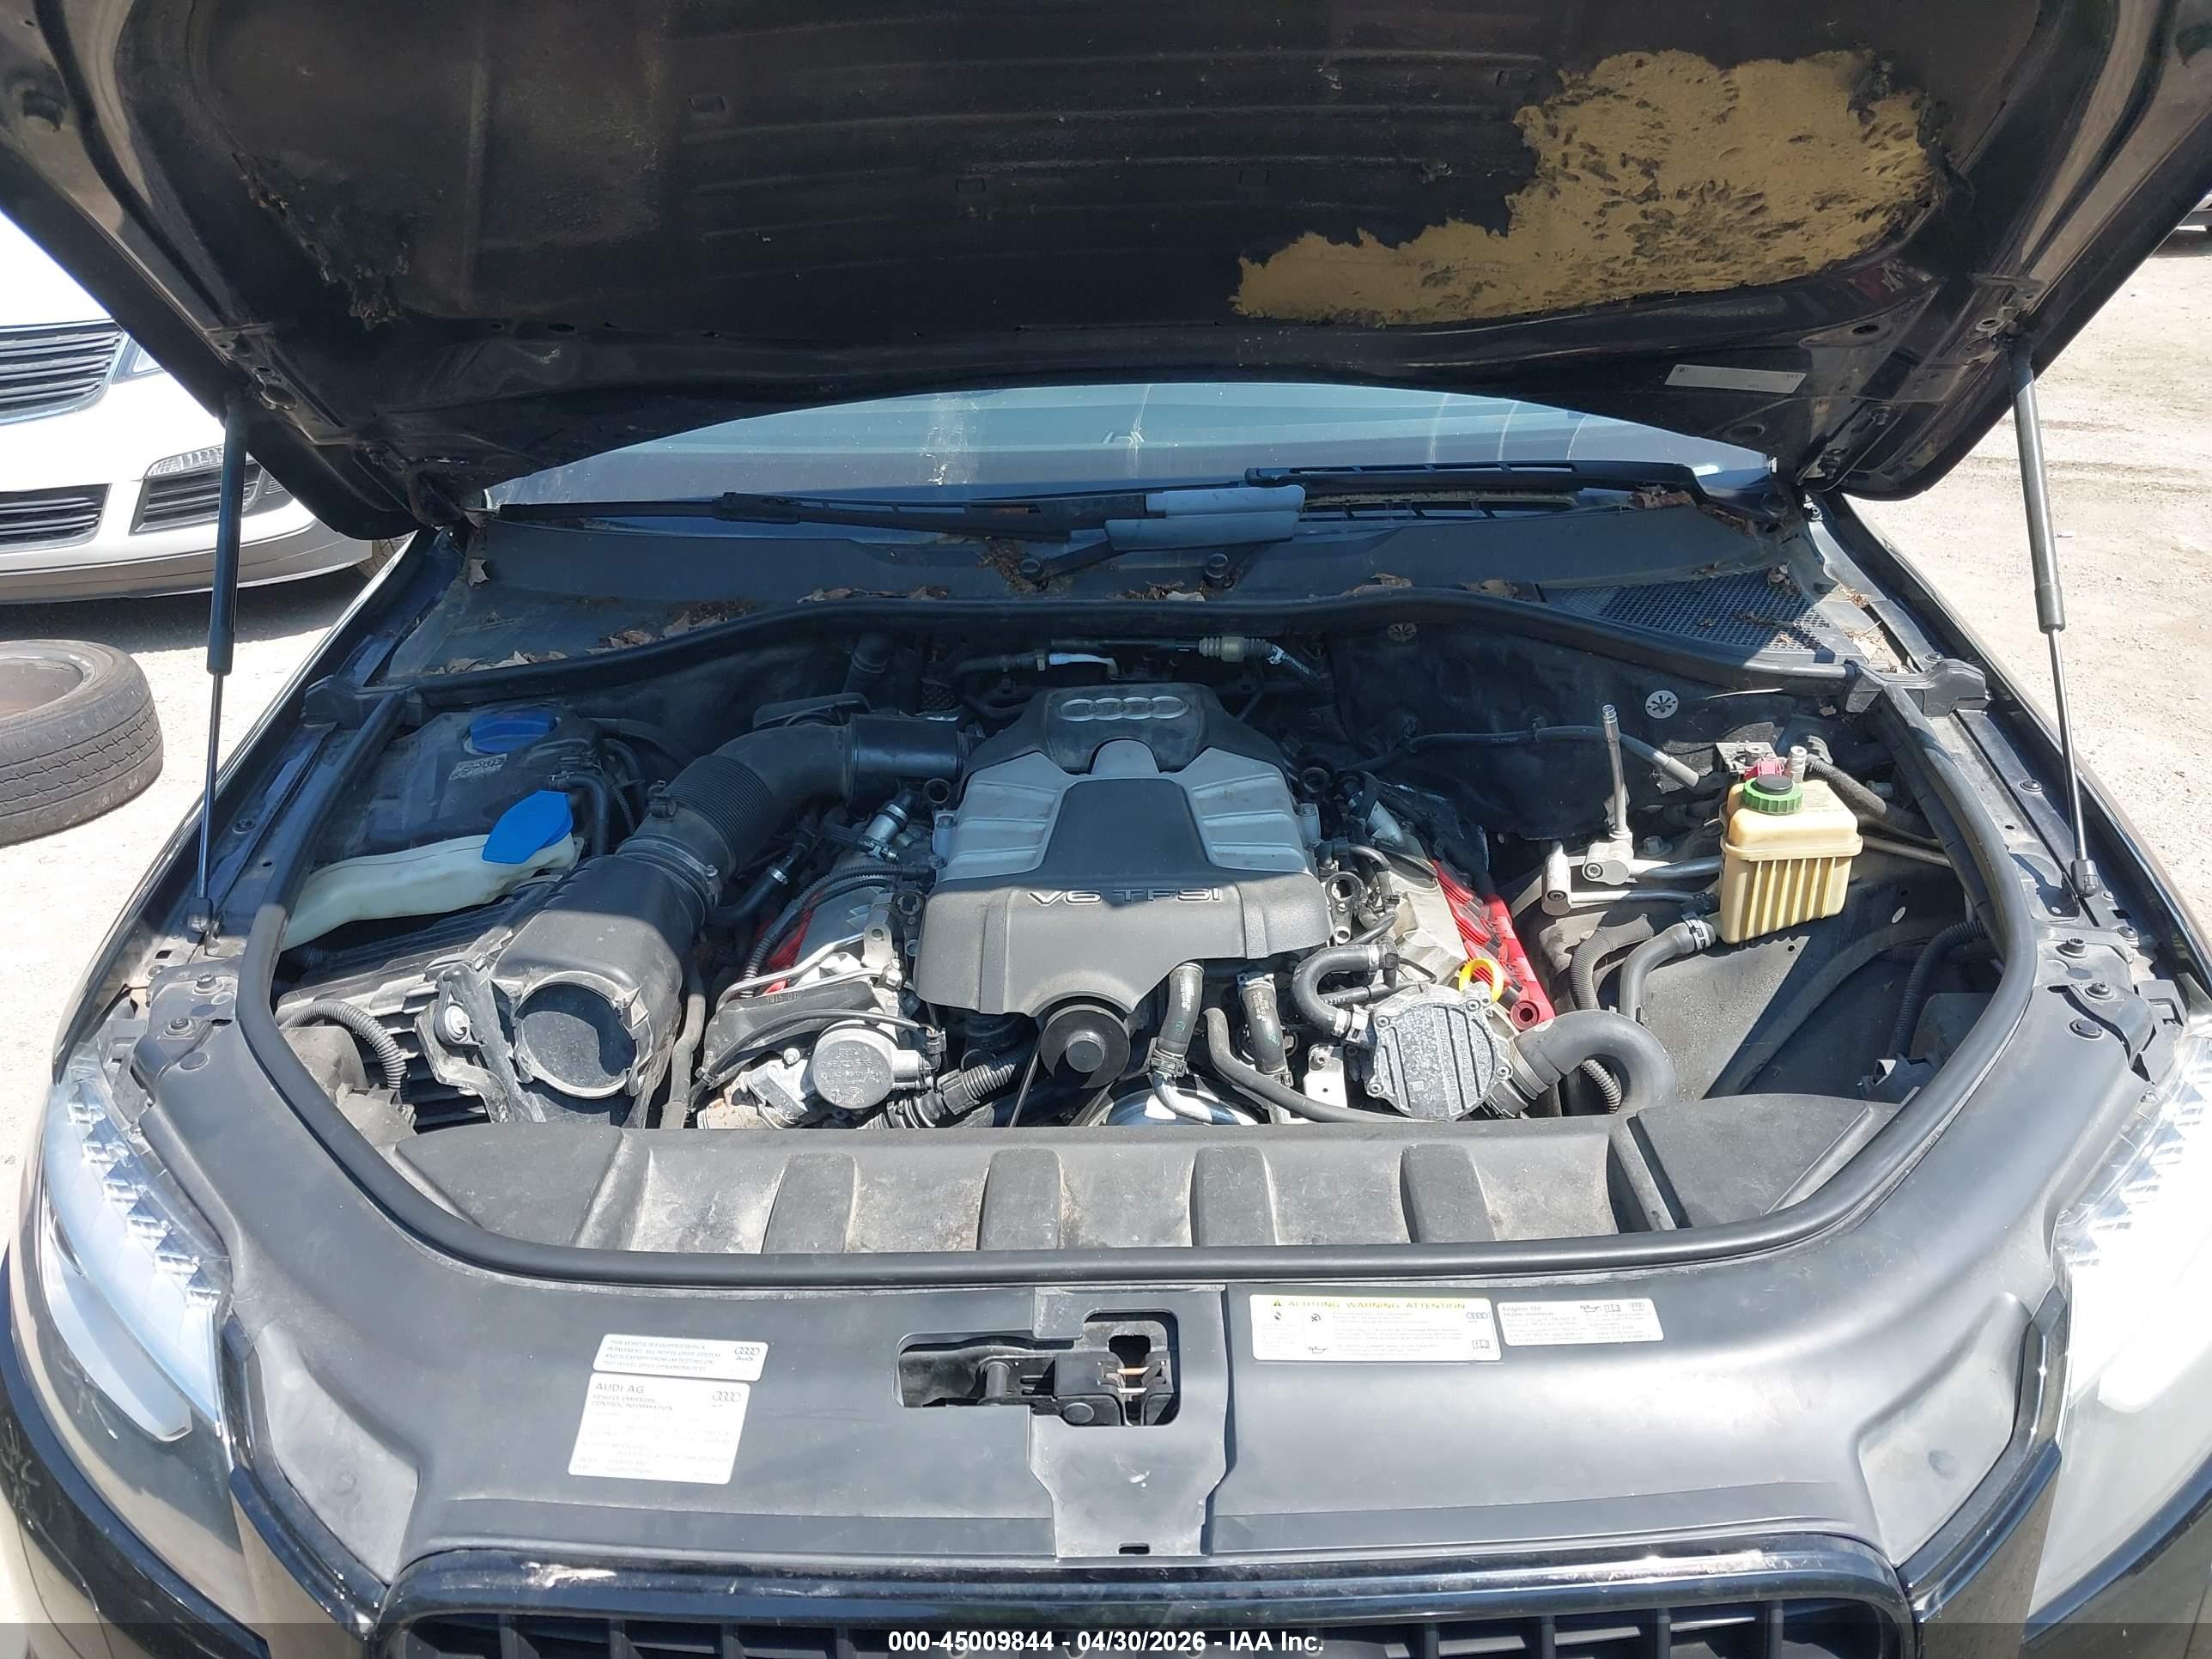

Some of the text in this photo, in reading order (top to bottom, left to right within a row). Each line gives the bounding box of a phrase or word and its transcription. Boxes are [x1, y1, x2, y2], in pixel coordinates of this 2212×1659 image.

[1030, 888, 1222, 907] V6 TFSI
[595, 1382, 646, 1394] AUDI AG
